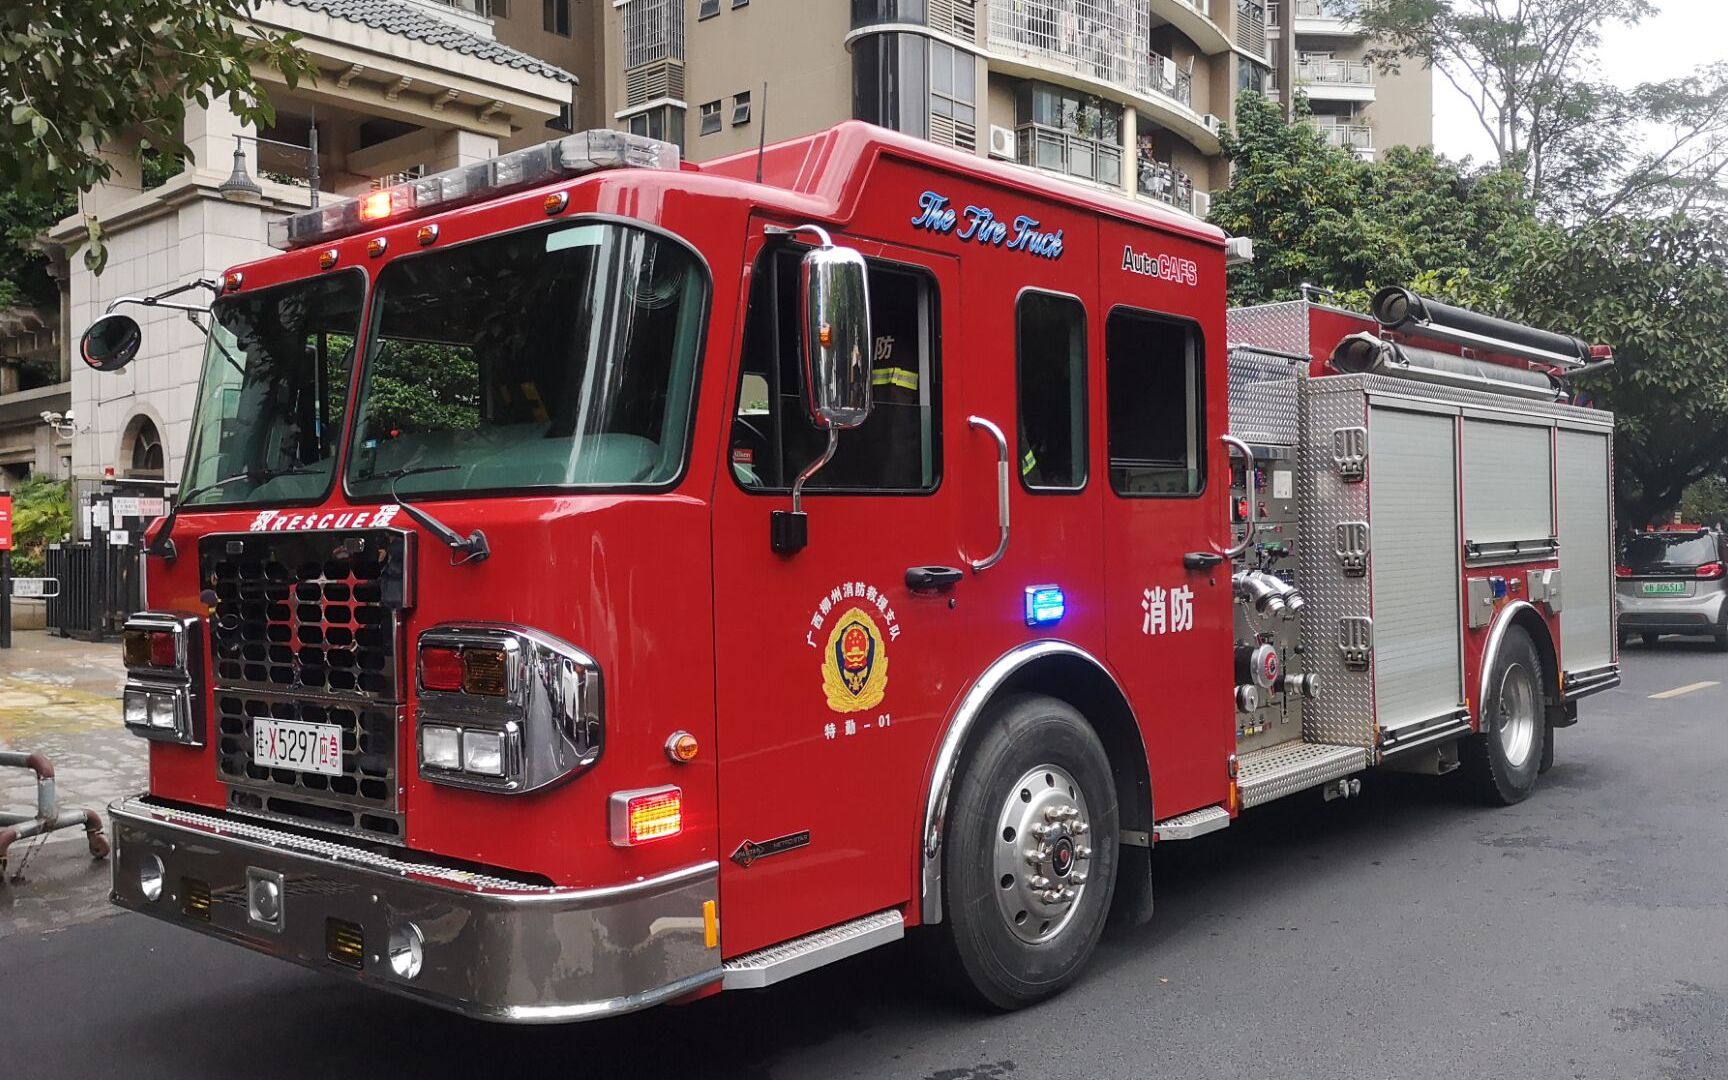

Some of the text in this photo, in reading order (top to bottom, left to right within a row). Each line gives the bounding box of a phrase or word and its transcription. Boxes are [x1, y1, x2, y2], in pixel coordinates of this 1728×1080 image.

[911, 191, 1063, 258] The Fire Truck
[1121, 245, 1197, 286] AutoCAFS
[271, 512, 370, 531] RESCUE
[1141, 584, 1194, 635] 消防
